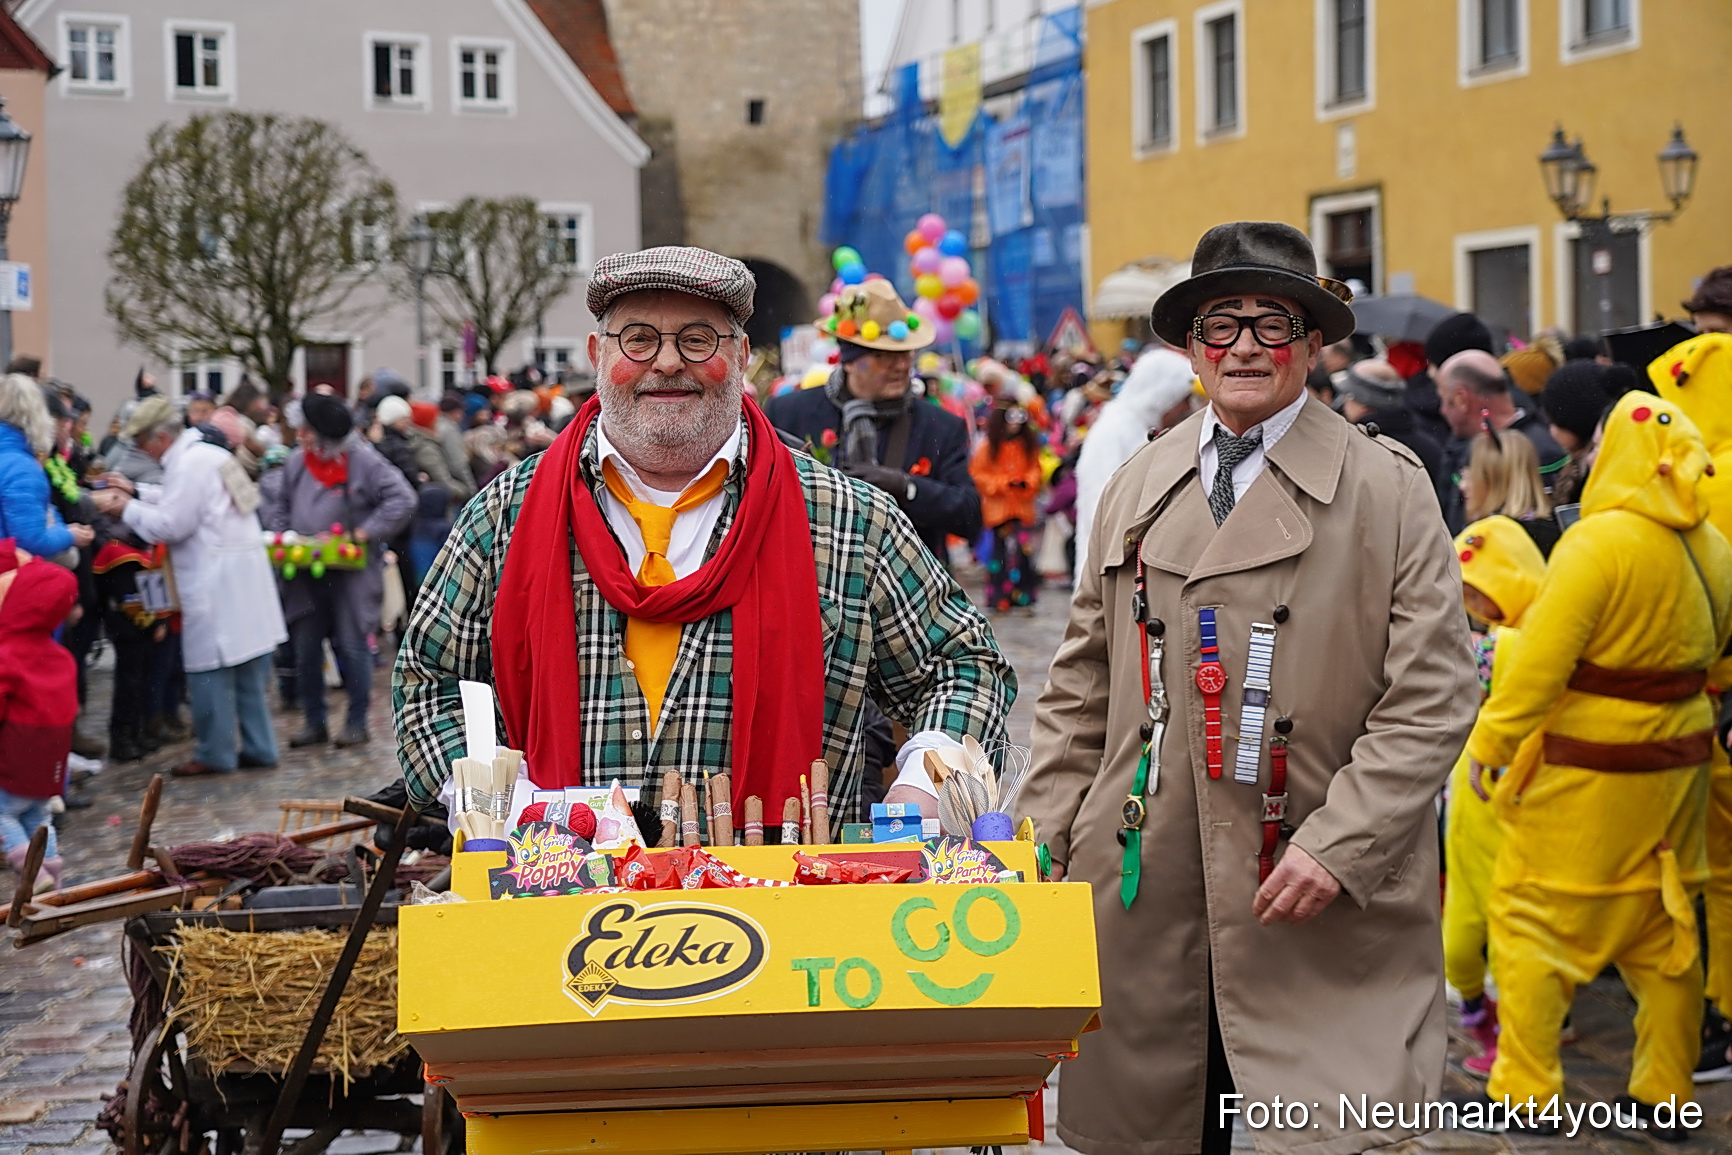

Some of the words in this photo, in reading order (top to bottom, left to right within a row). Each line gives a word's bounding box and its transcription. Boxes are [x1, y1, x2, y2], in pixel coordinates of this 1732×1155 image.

[568, 903, 735, 970] Edeka
[791, 957, 883, 1008] TO
[891, 886, 1021, 962] GO
[577, 983, 607, 993] EDEKA
